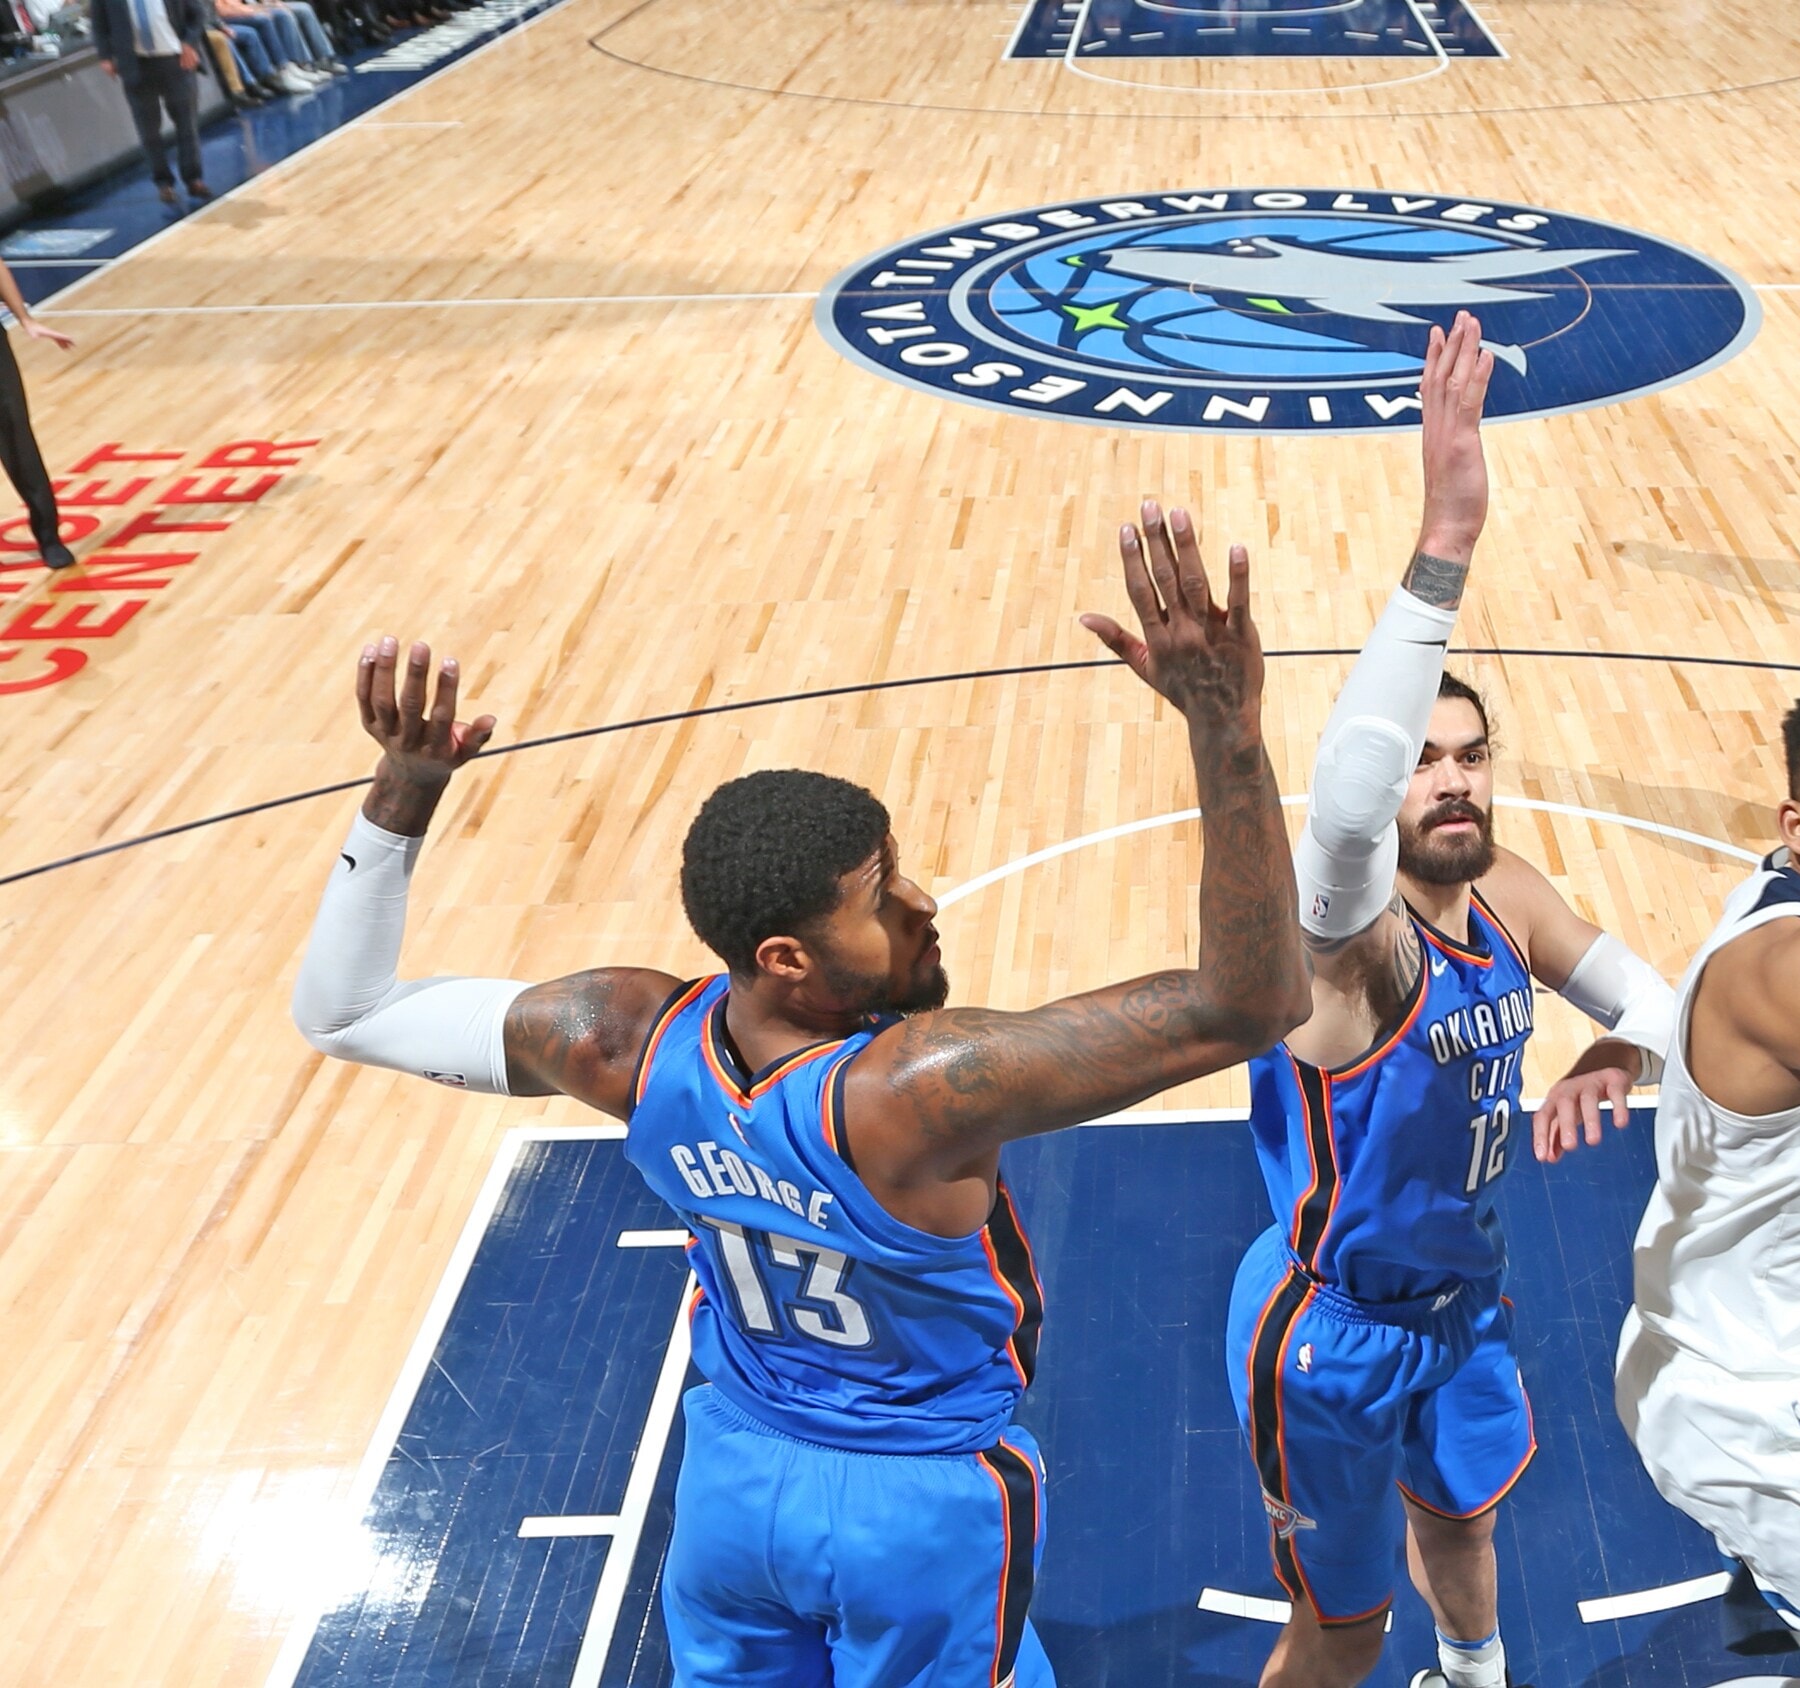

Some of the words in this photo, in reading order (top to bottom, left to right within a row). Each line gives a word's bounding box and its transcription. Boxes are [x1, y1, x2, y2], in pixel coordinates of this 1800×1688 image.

[870, 193, 1548, 288] TIMBERWOLVES
[860, 300, 1423, 422] MINNESOTA
[1429, 987, 1533, 1065] OKLAHO
[670, 1141, 835, 1231] GEORGE
[1464, 1098, 1511, 1193] 12
[697, 1213, 875, 1349] 13
